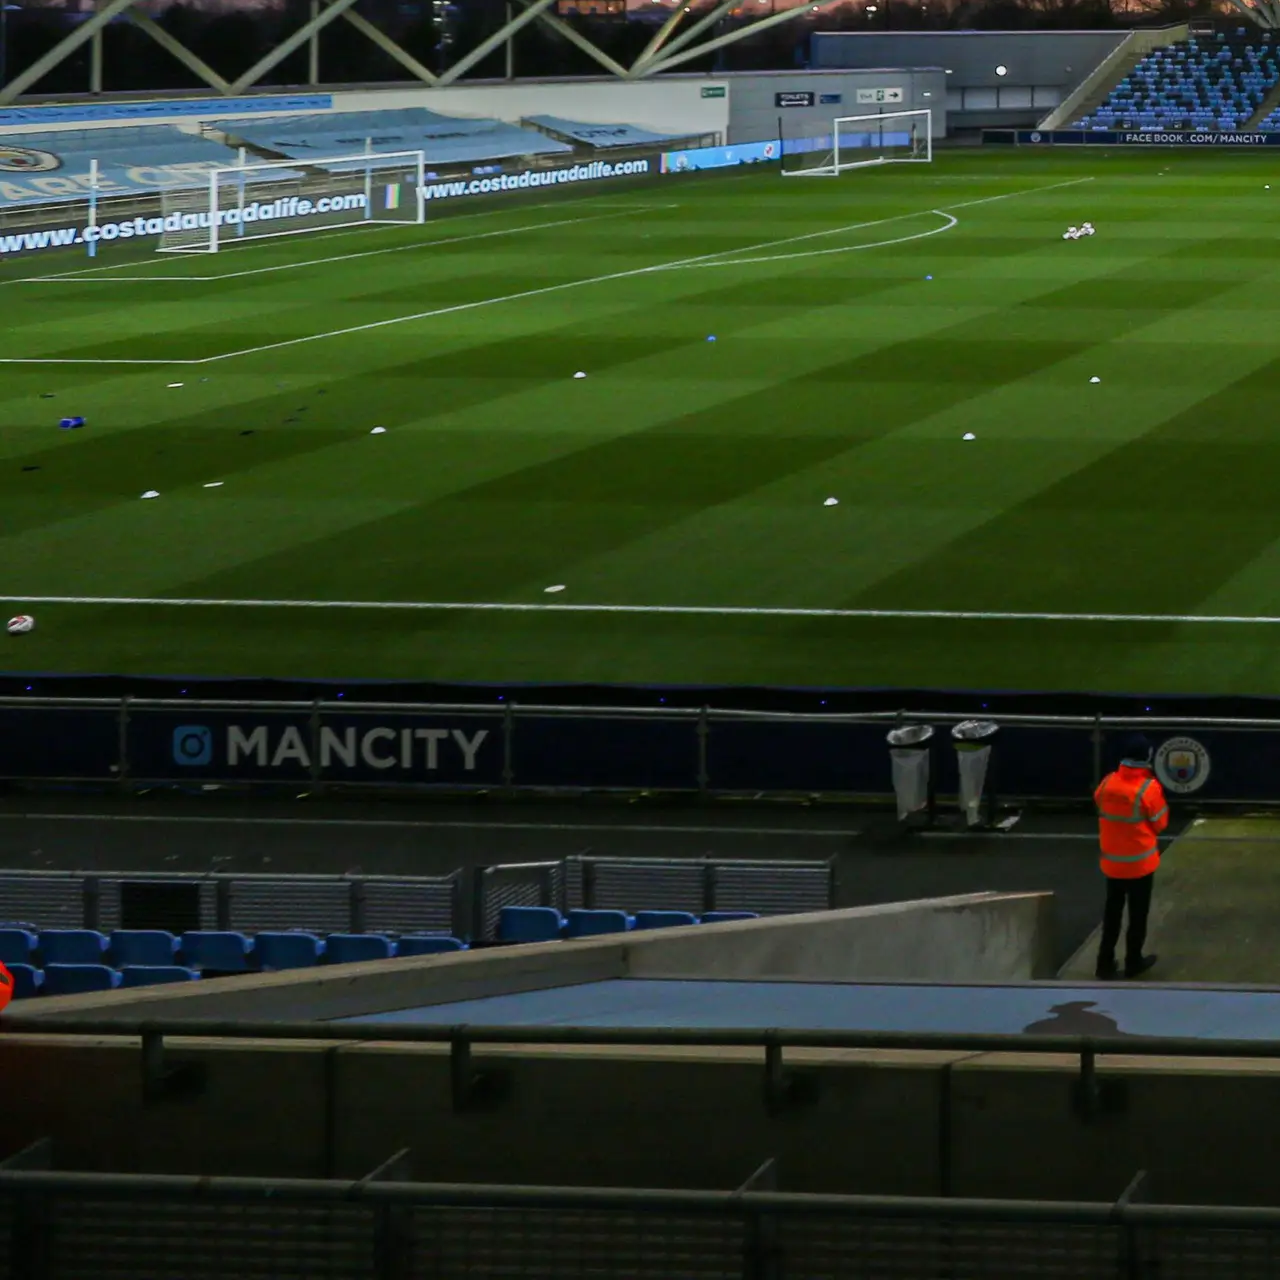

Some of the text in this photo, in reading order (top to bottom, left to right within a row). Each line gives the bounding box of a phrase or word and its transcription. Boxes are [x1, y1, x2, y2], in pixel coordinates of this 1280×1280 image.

[416, 159, 648, 200] www.costadauradalife.com
[0, 193, 365, 253] www.costadauradalife.com
[227, 726, 487, 770] MANCITY
